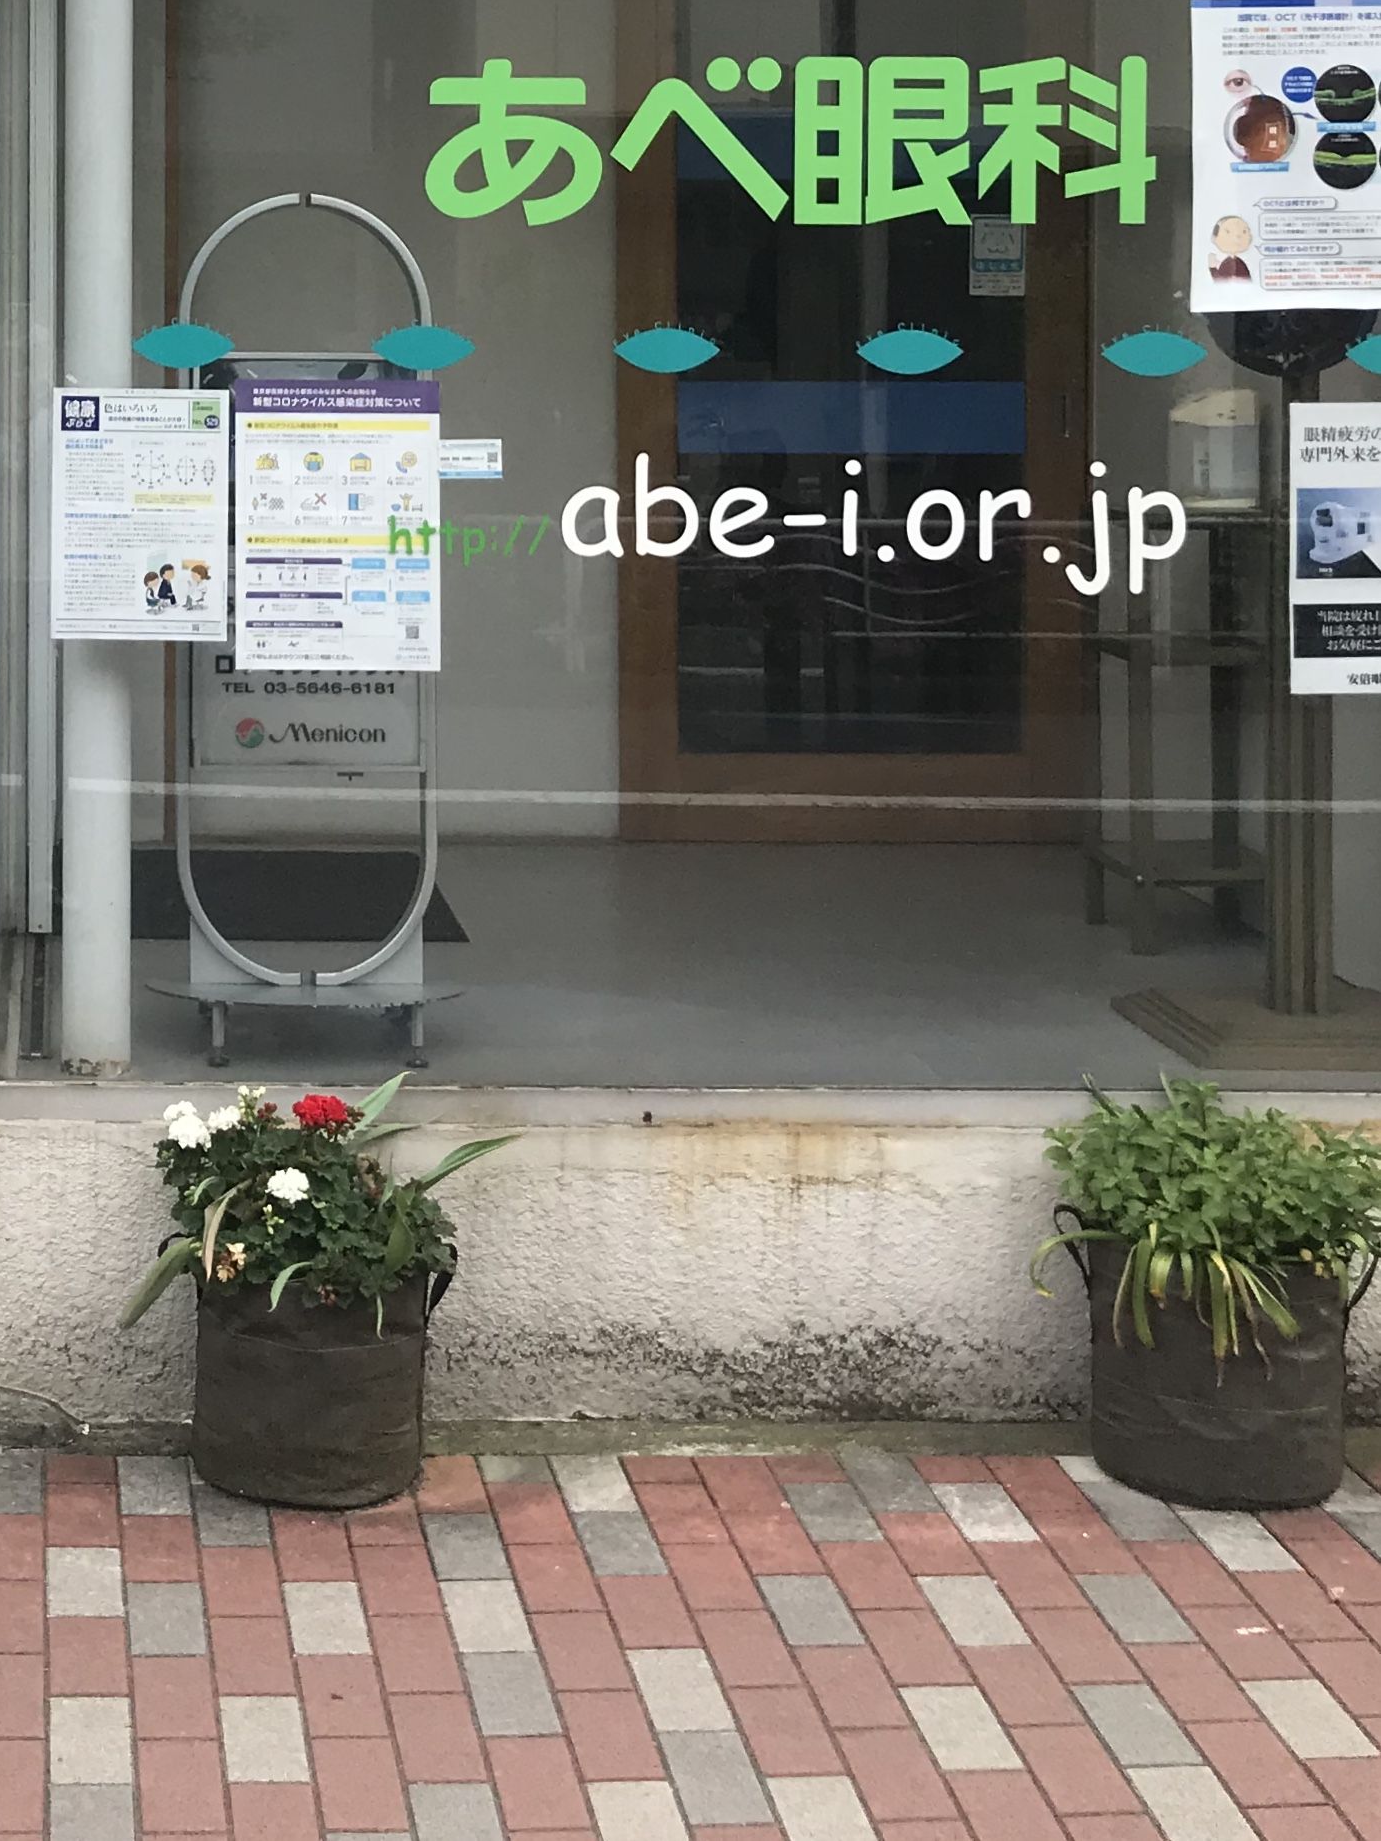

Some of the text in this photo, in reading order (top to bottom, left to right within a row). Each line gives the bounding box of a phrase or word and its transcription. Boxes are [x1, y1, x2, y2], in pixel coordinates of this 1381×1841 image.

[424, 55, 1157, 227] あべ眼科
[104, 403, 158, 414] 色はいろいろ
[253, 396, 422, 408] 新型コロナウイルス感染症対策について
[560, 452, 1186, 596] abe-i.or.jp
[222, 682, 395, 695] TEL 03-5646-6181
[270, 722, 386, 744] Menicon
